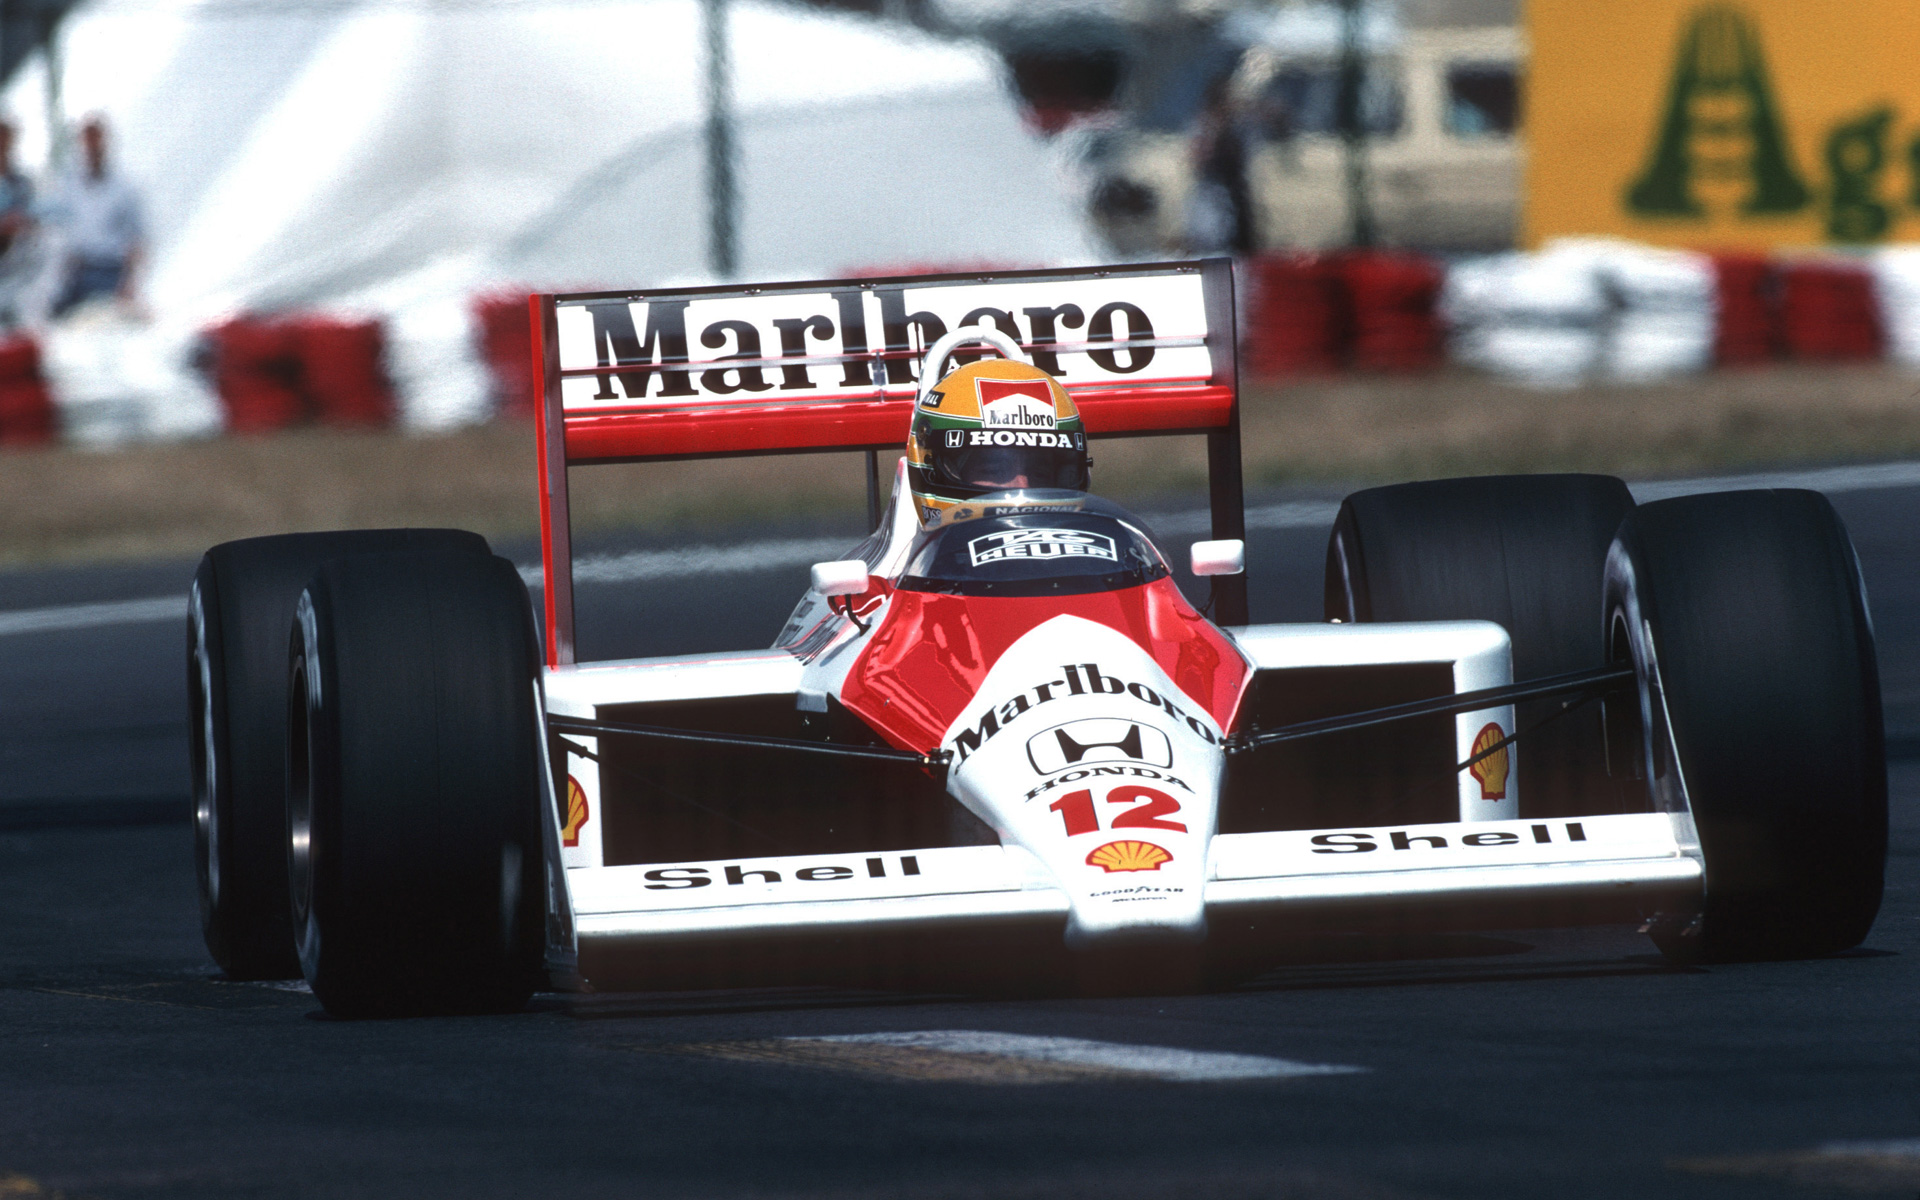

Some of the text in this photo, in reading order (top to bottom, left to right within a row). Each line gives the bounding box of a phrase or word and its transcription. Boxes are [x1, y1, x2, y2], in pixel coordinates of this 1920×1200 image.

[1621, 2, 1920, 245] Ag
[585, 290, 1155, 400] Marlboro
[989, 405, 1054, 427] Marlboro
[970, 431, 1073, 448] HONDA
[980, 543, 1108, 561] HEUER
[988, 530, 1095, 545] TAG
[952, 663, 1216, 776] Marlboro
[1024, 766, 1196, 803] HONDA
[1049, 785, 1188, 837] 12
[1310, 822, 1587, 854] Shell
[644, 855, 921, 890] Shell
